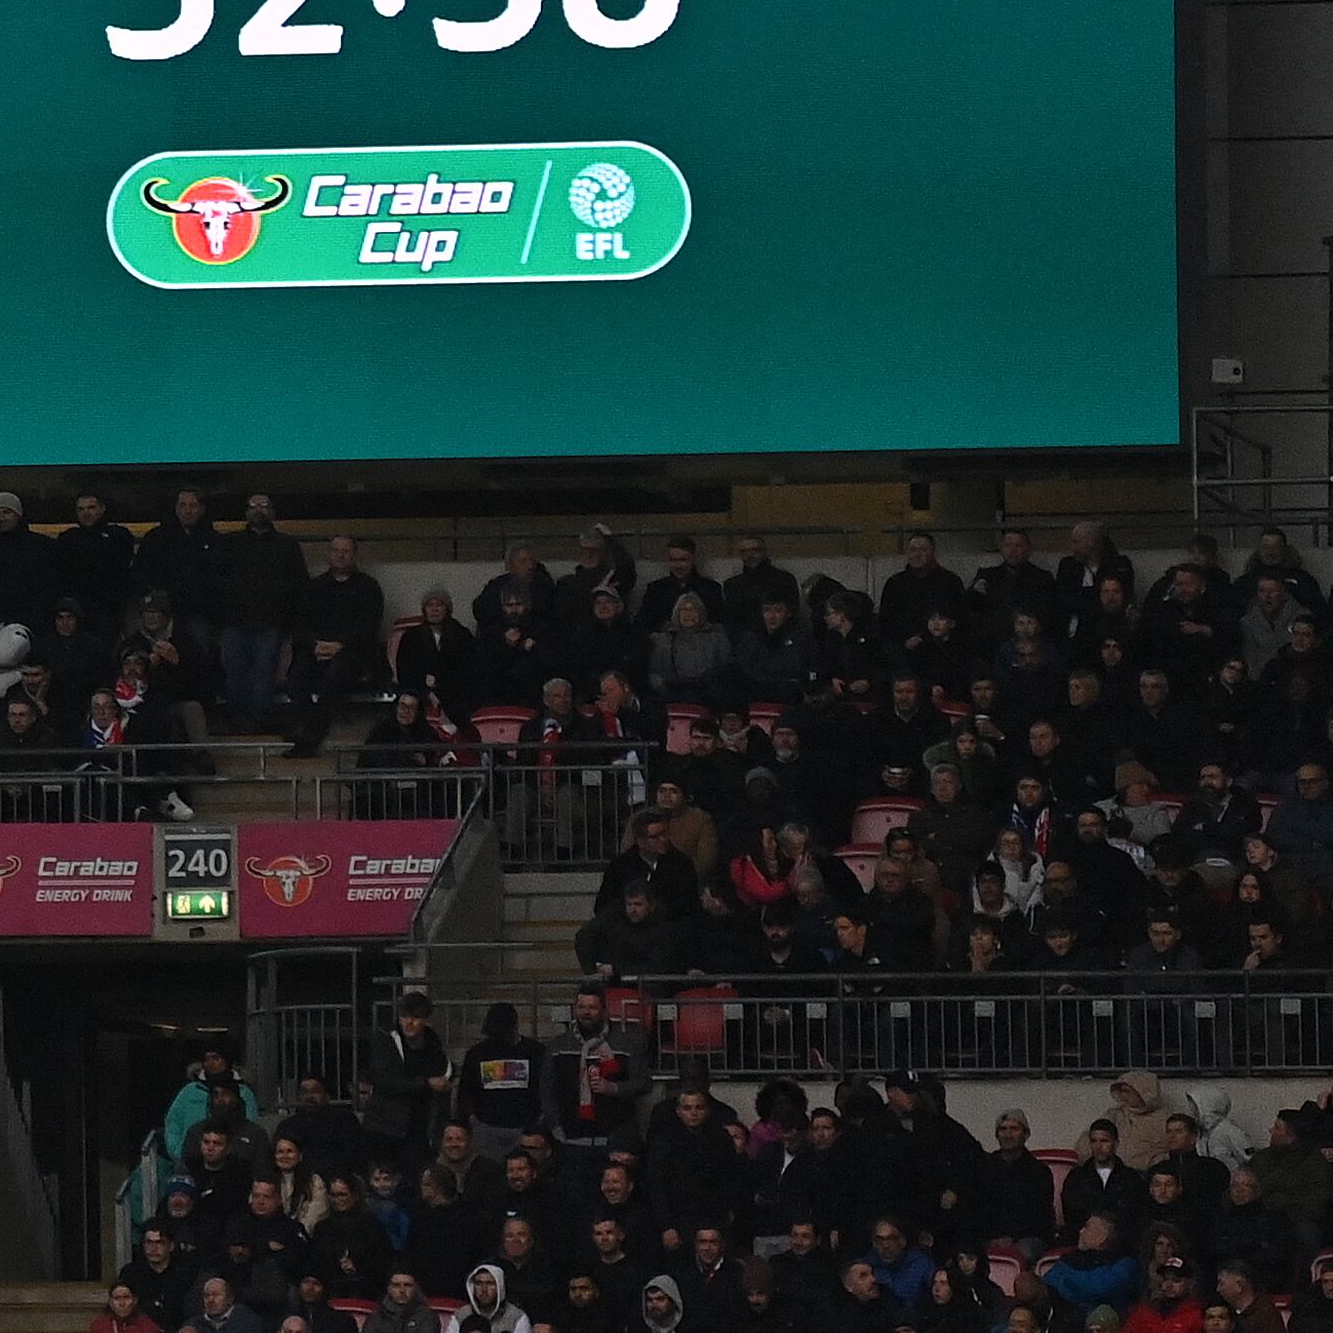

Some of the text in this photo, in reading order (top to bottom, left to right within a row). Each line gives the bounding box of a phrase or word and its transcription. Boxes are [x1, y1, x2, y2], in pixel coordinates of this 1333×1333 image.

[303, 173, 515, 217] Carabao
[359, 222, 460, 272] Cup
[576, 233, 631, 261] EFL
[38, 856, 139, 877] Carabao
[167, 849, 228, 878] 240
[35, 889, 134, 903] ENERGY DRINK
[346, 887, 401, 902] ENERGY
